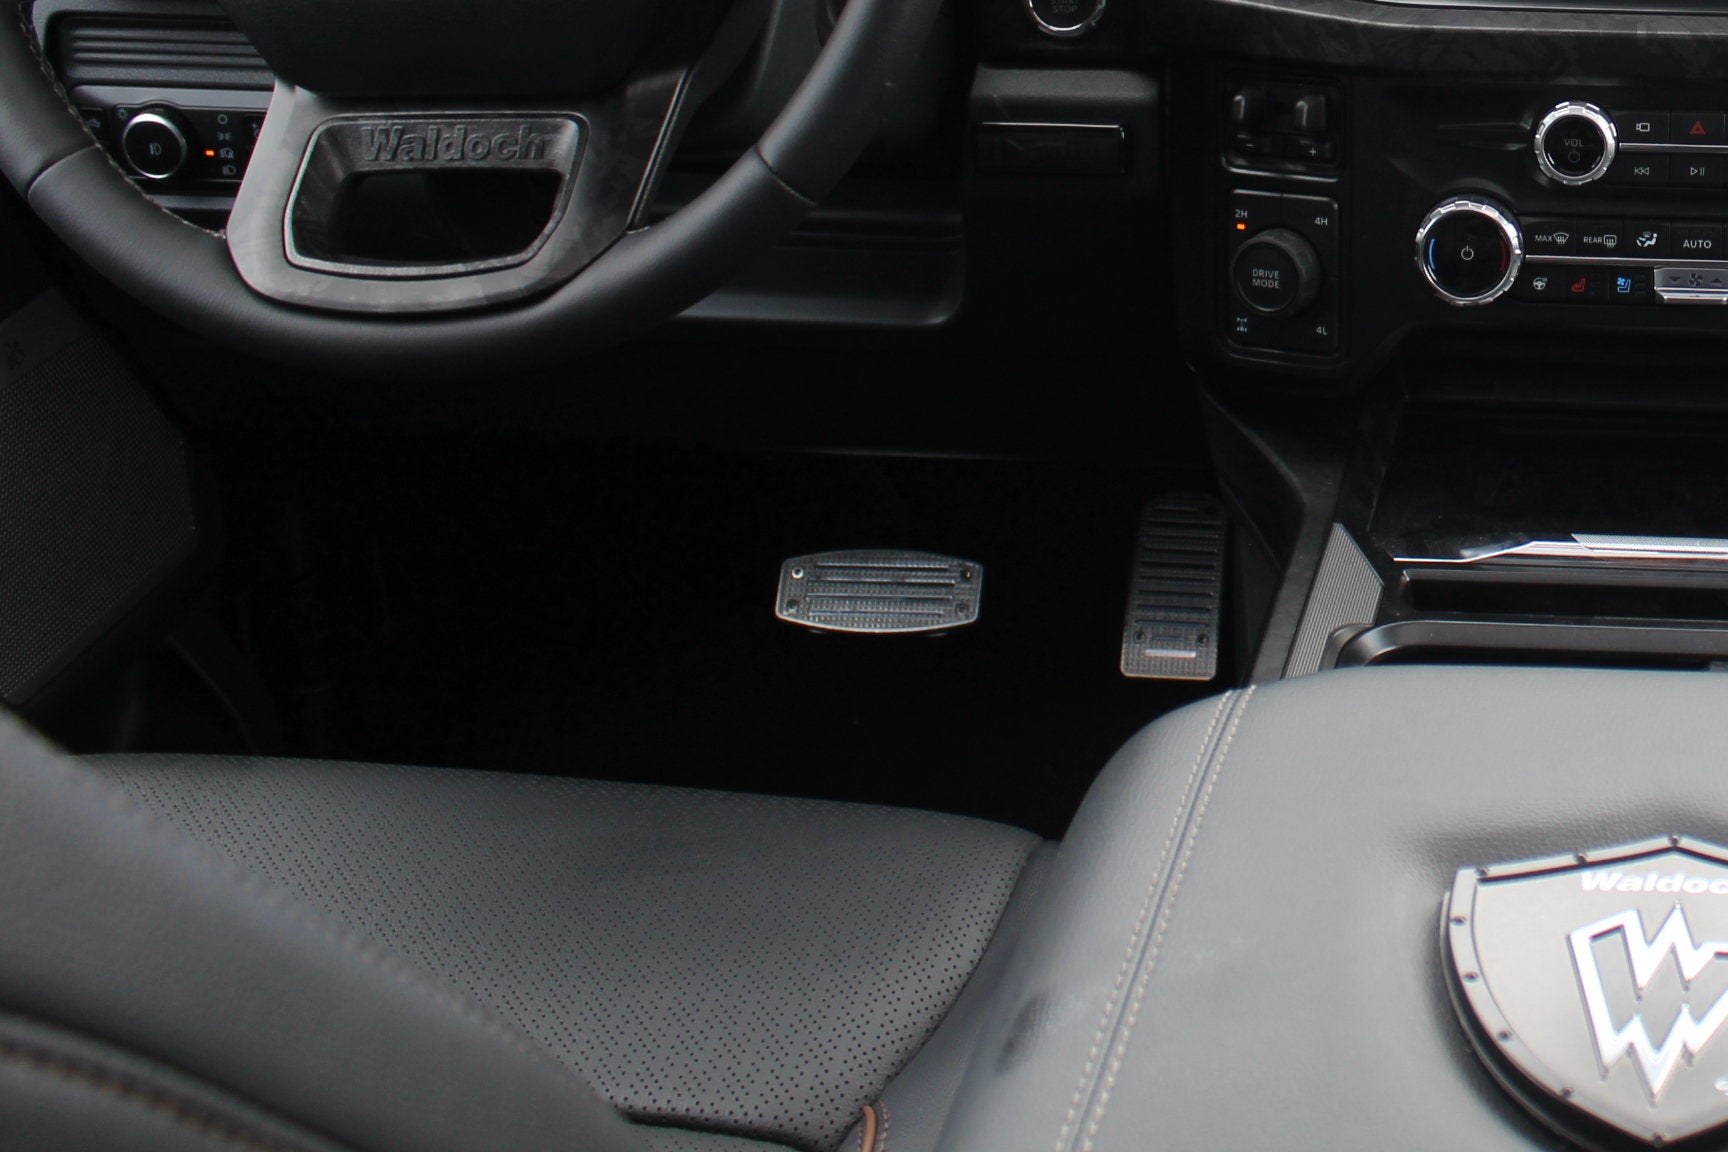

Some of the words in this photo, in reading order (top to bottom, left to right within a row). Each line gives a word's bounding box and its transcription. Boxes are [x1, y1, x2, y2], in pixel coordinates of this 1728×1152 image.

[361, 125, 546, 162] Waldoch
[1564, 138, 1584, 148] VOL
[1235, 209, 1248, 218] 2H
[1314, 217, 1328, 226] 4H
[1535, 234, 1553, 243] MAX
[1583, 235, 1603, 244] REAR
[1682, 239, 1712, 250] AUTO
[1252, 269, 1279, 279] DRIVE
[1252, 278, 1280, 289] MODE
[1316, 326, 1328, 335] 4L
